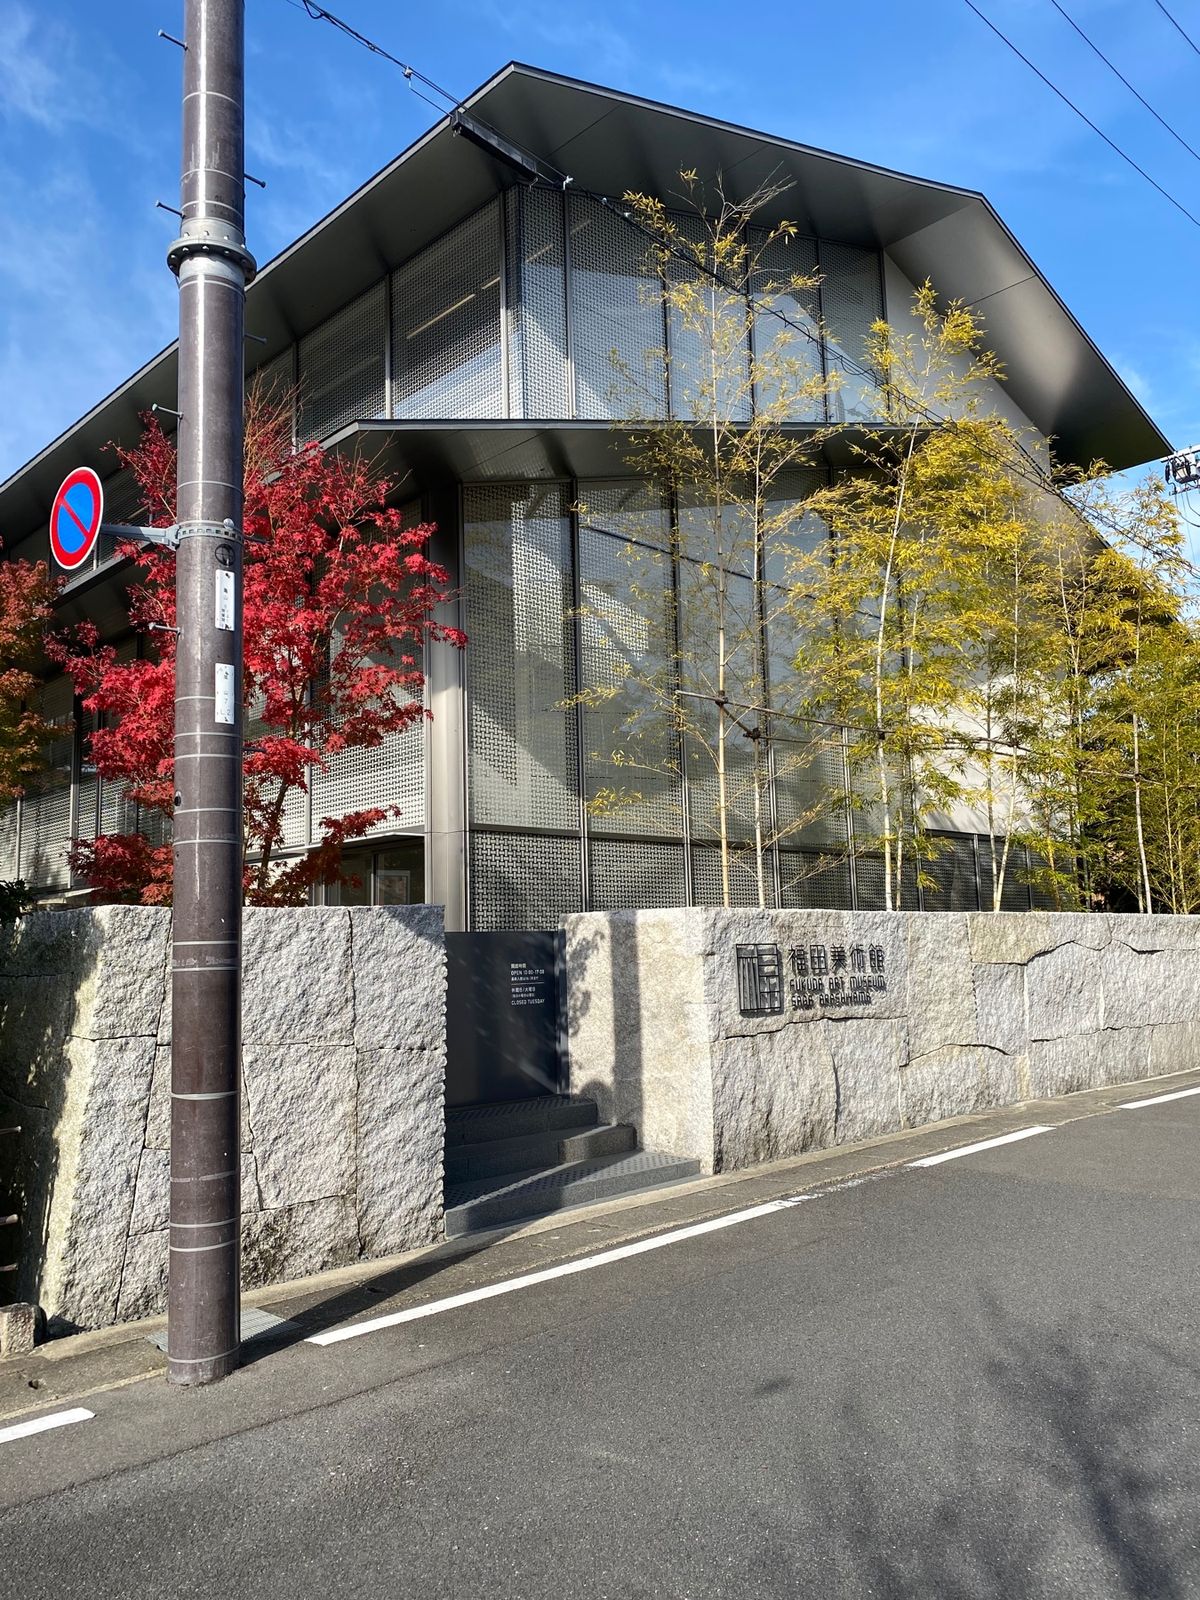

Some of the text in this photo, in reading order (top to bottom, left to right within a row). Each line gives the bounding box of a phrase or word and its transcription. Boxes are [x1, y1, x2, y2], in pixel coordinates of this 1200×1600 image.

[786, 943, 885, 972] 福田美術館
[790, 975, 886, 991] FUKUDA ART MUSEUM
[792, 991, 872, 1009] SAGA ARASHIYAMA
